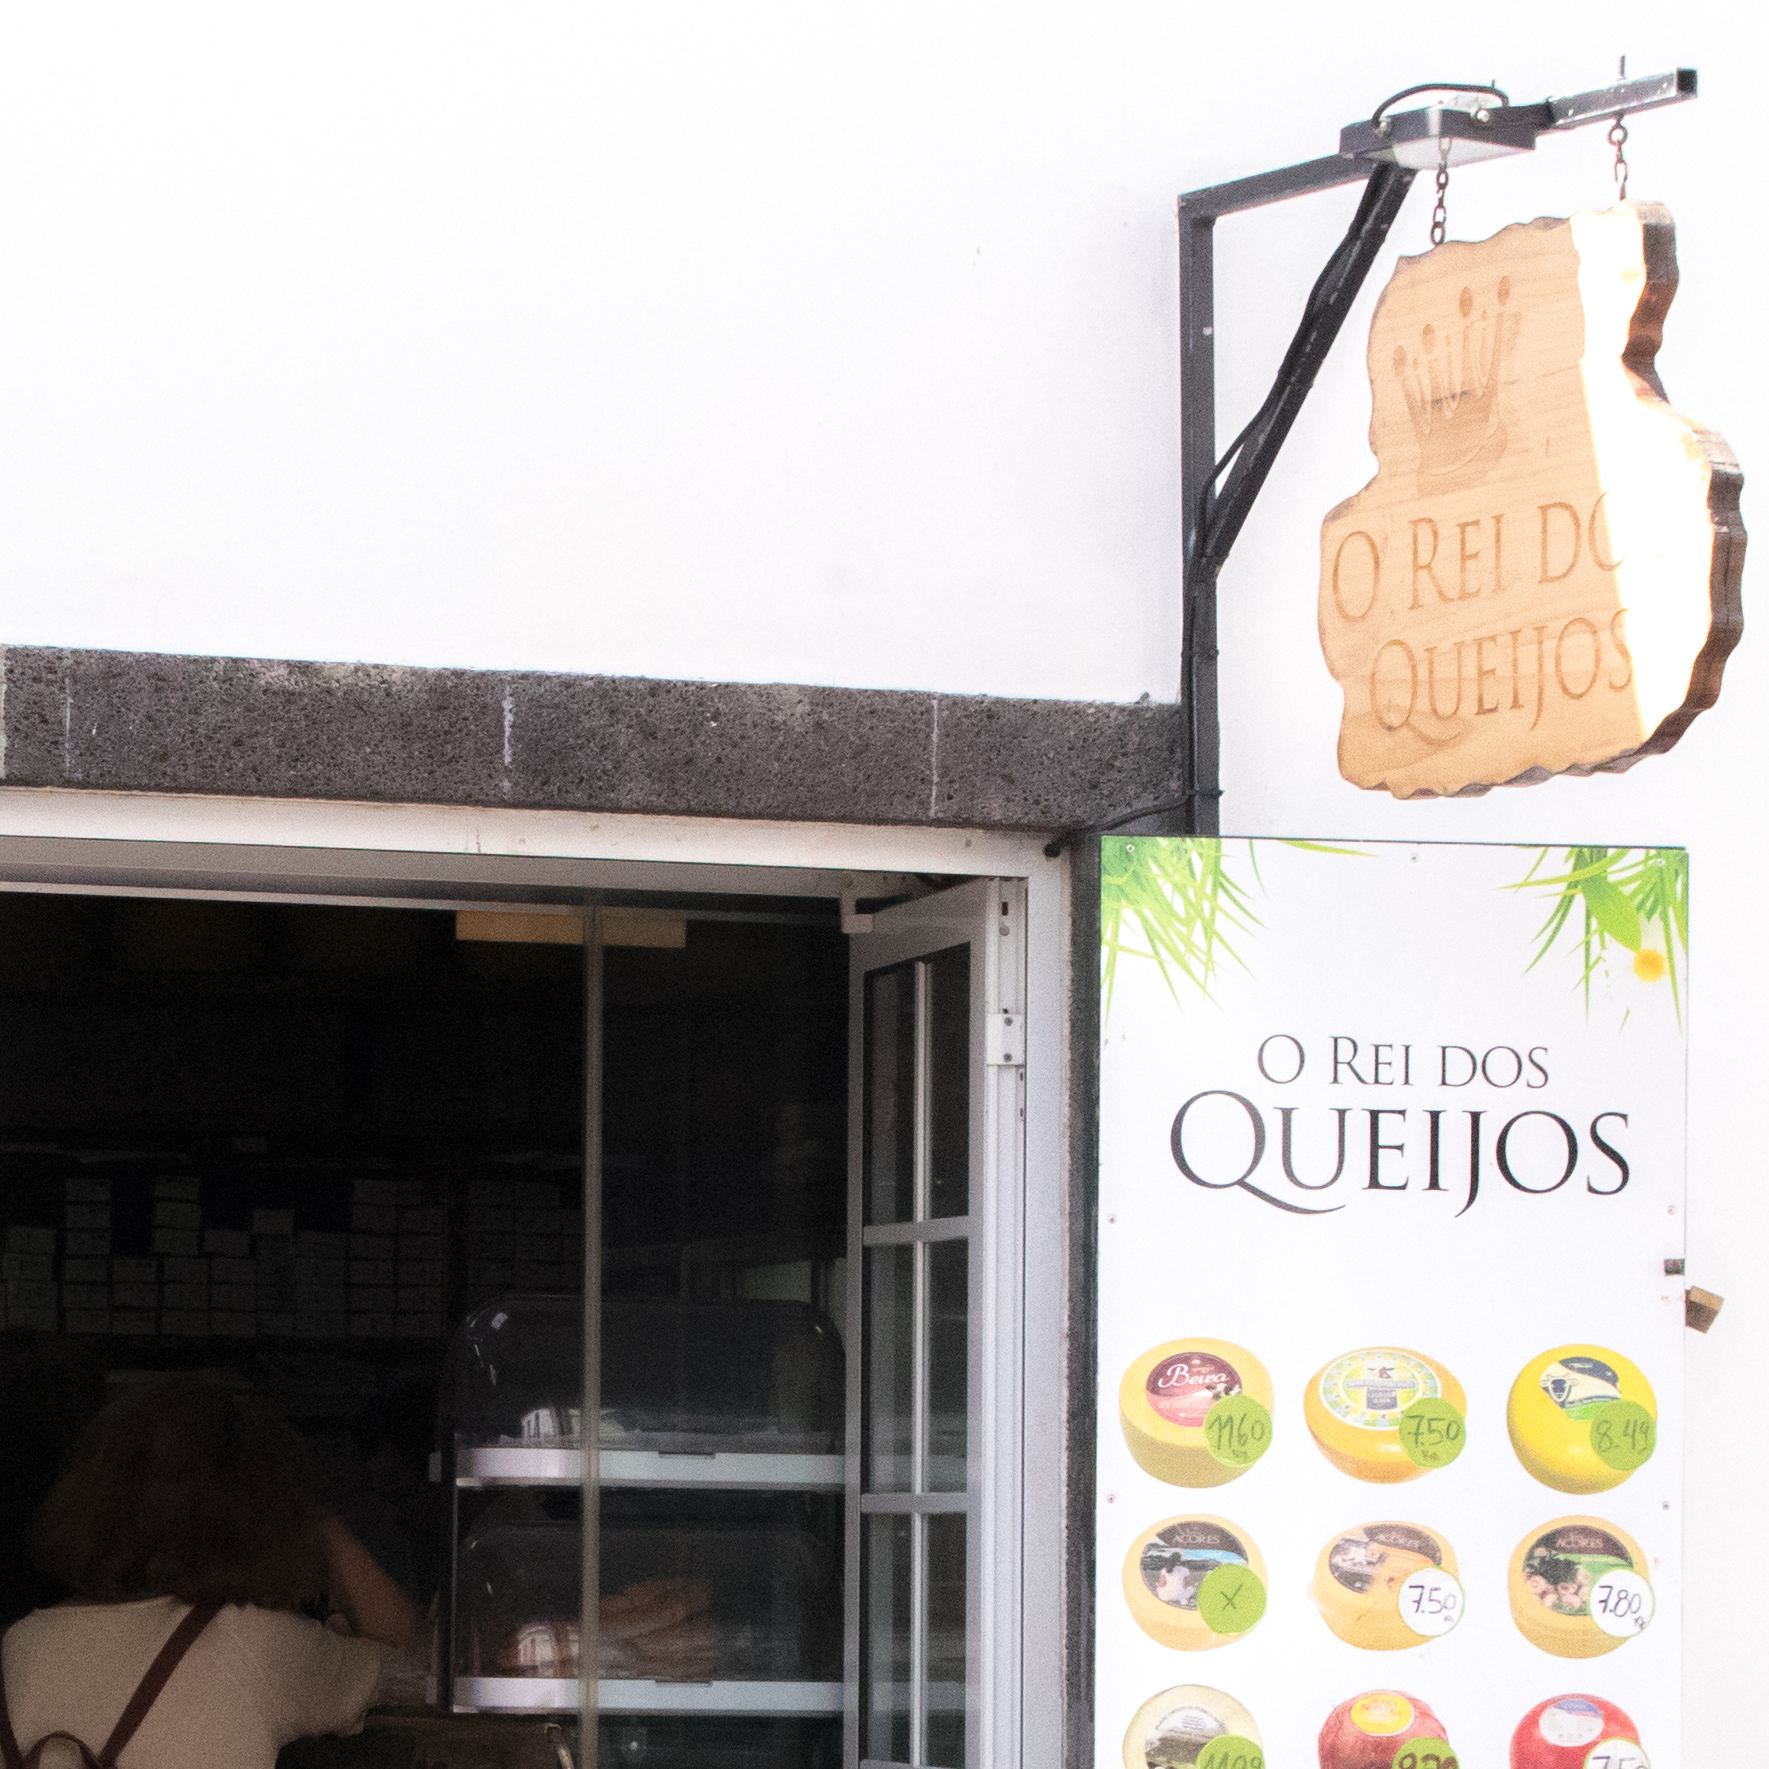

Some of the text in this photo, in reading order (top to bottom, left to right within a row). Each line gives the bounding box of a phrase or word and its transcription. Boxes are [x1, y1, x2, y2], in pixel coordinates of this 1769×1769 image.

[1332, 489, 1635, 623] O REI DO
[1371, 607, 1631, 748] QUEIJOS
[1257, 1034, 1549, 1089] O REI DOS
[1169, 1089, 1631, 1218] QUEIJOS
[1158, 1363, 1229, 1387] Beira
[1408, 1585, 1457, 1614] 7.50
[1598, 1585, 1642, 1617] 7.80
